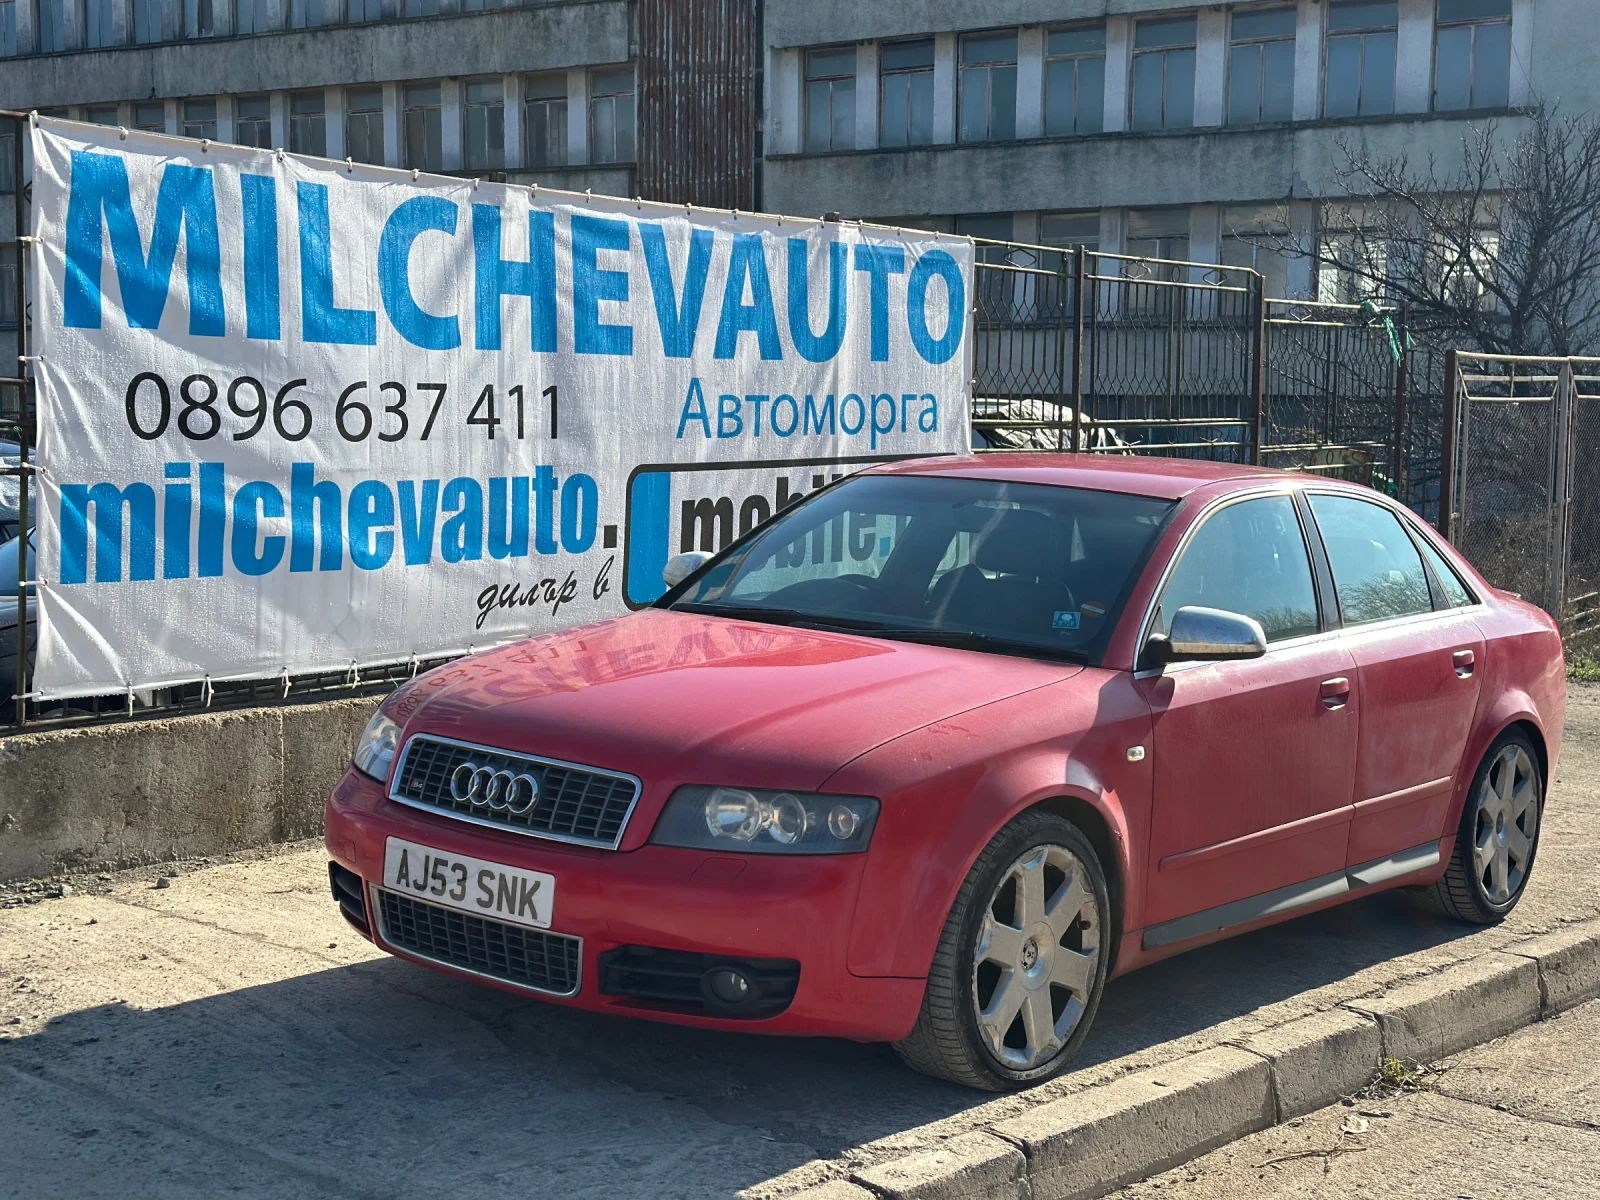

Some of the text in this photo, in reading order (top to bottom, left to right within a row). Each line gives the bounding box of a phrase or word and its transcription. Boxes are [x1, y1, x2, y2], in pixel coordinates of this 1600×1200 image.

[64, 150, 966, 365] MILCHEVAUTO
[125, 372, 558, 442] 0896 637 411
[676, 377, 938, 450] Автоморга
[476, 571, 578, 629] дилър
[396, 848, 541, 920] AJ53 SNK
